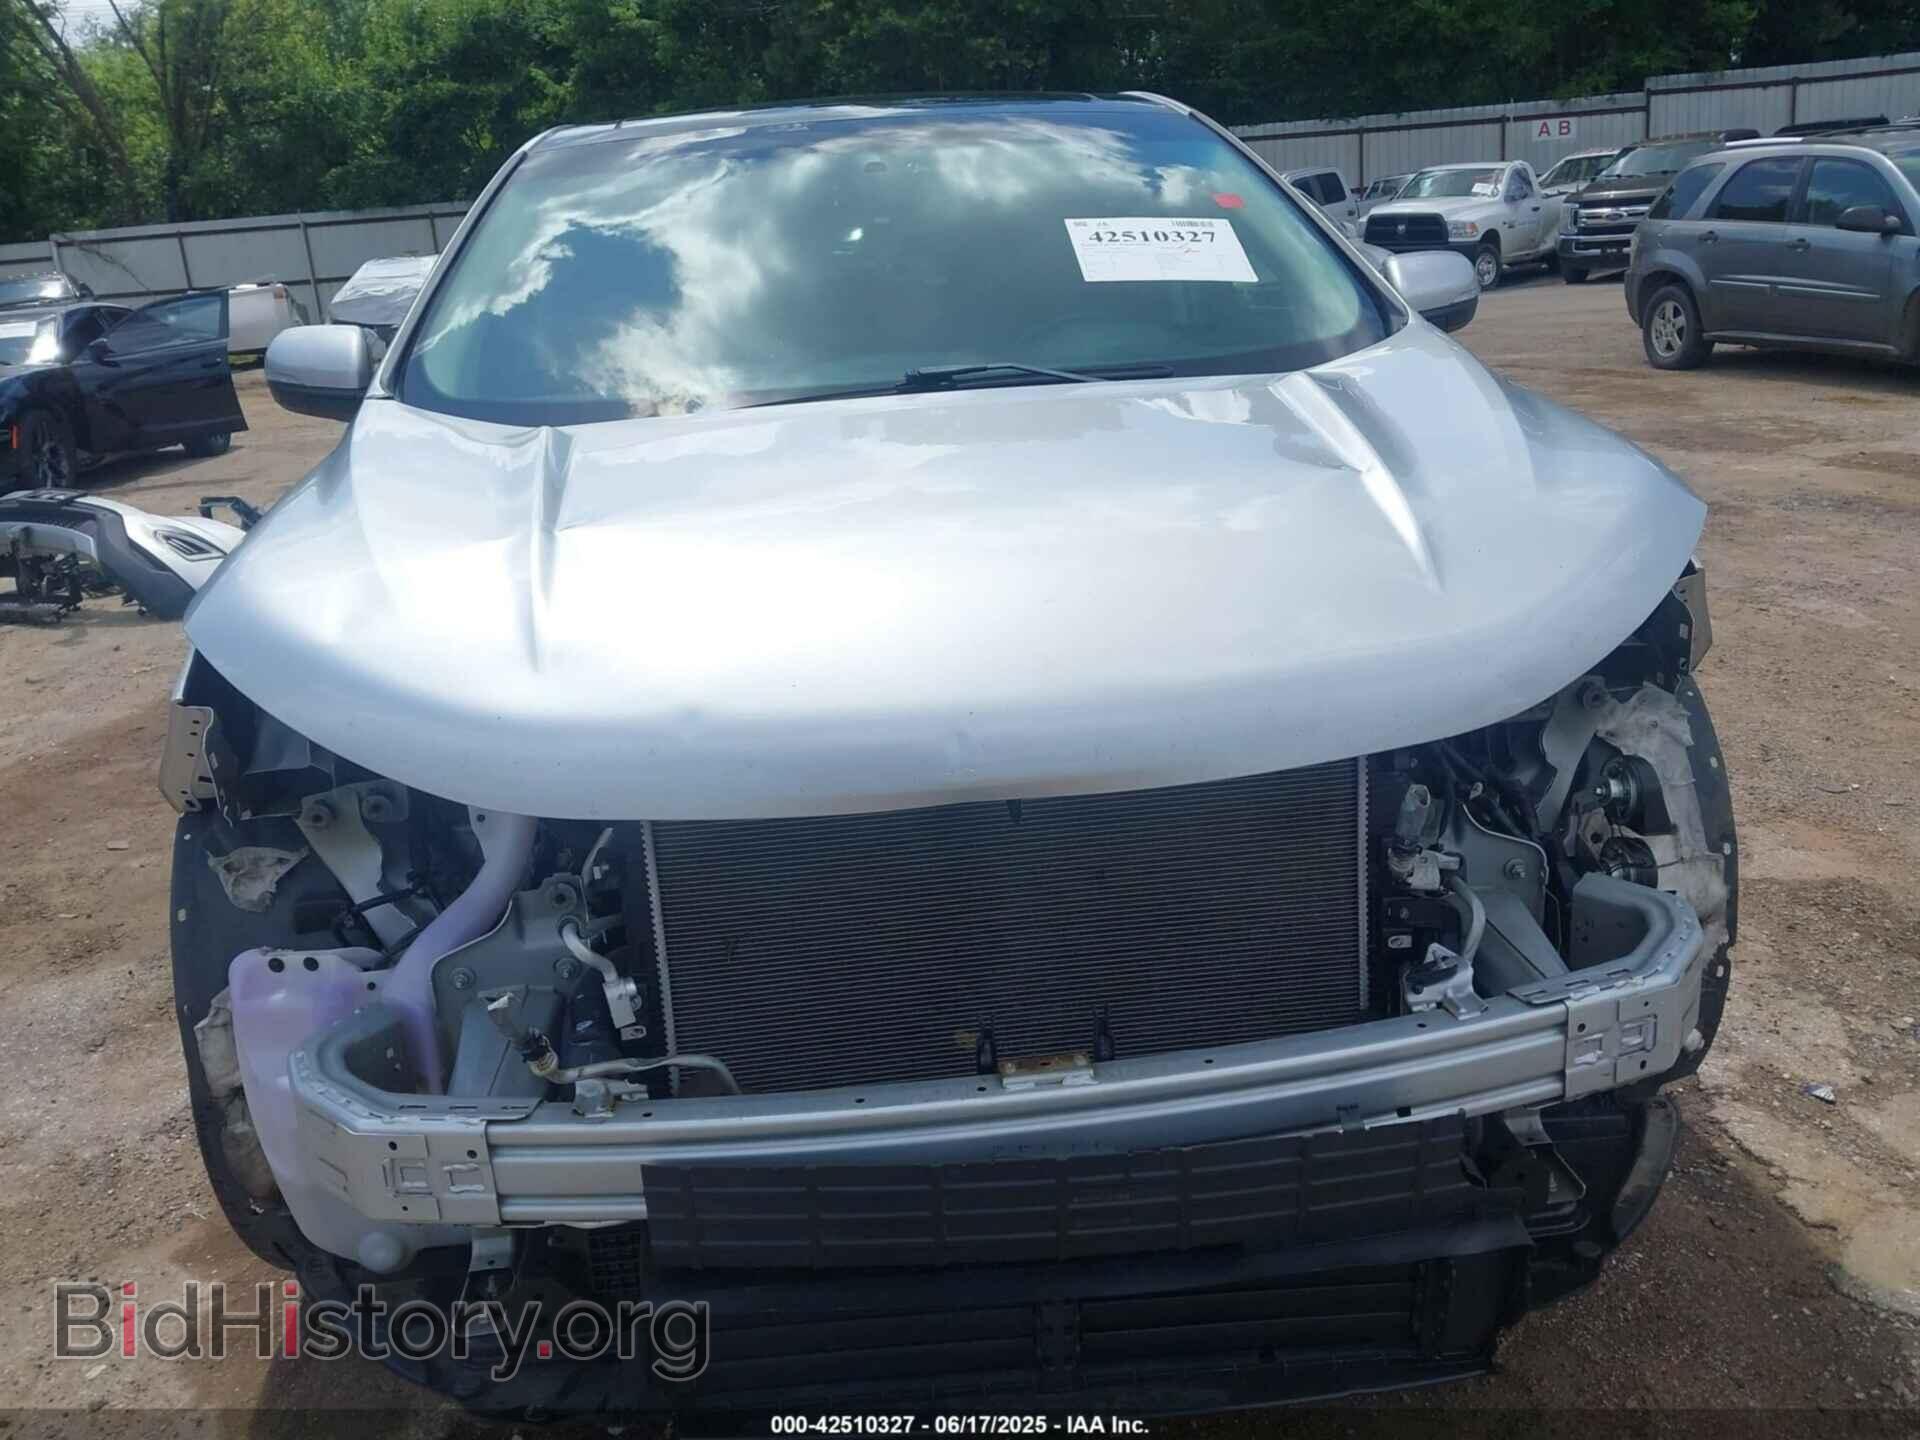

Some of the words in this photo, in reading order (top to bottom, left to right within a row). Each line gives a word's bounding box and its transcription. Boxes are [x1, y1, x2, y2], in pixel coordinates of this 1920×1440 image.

[1538, 120, 1551, 137] A
[1559, 120, 1570, 136] B
[1088, 231, 1216, 243] 42510327
